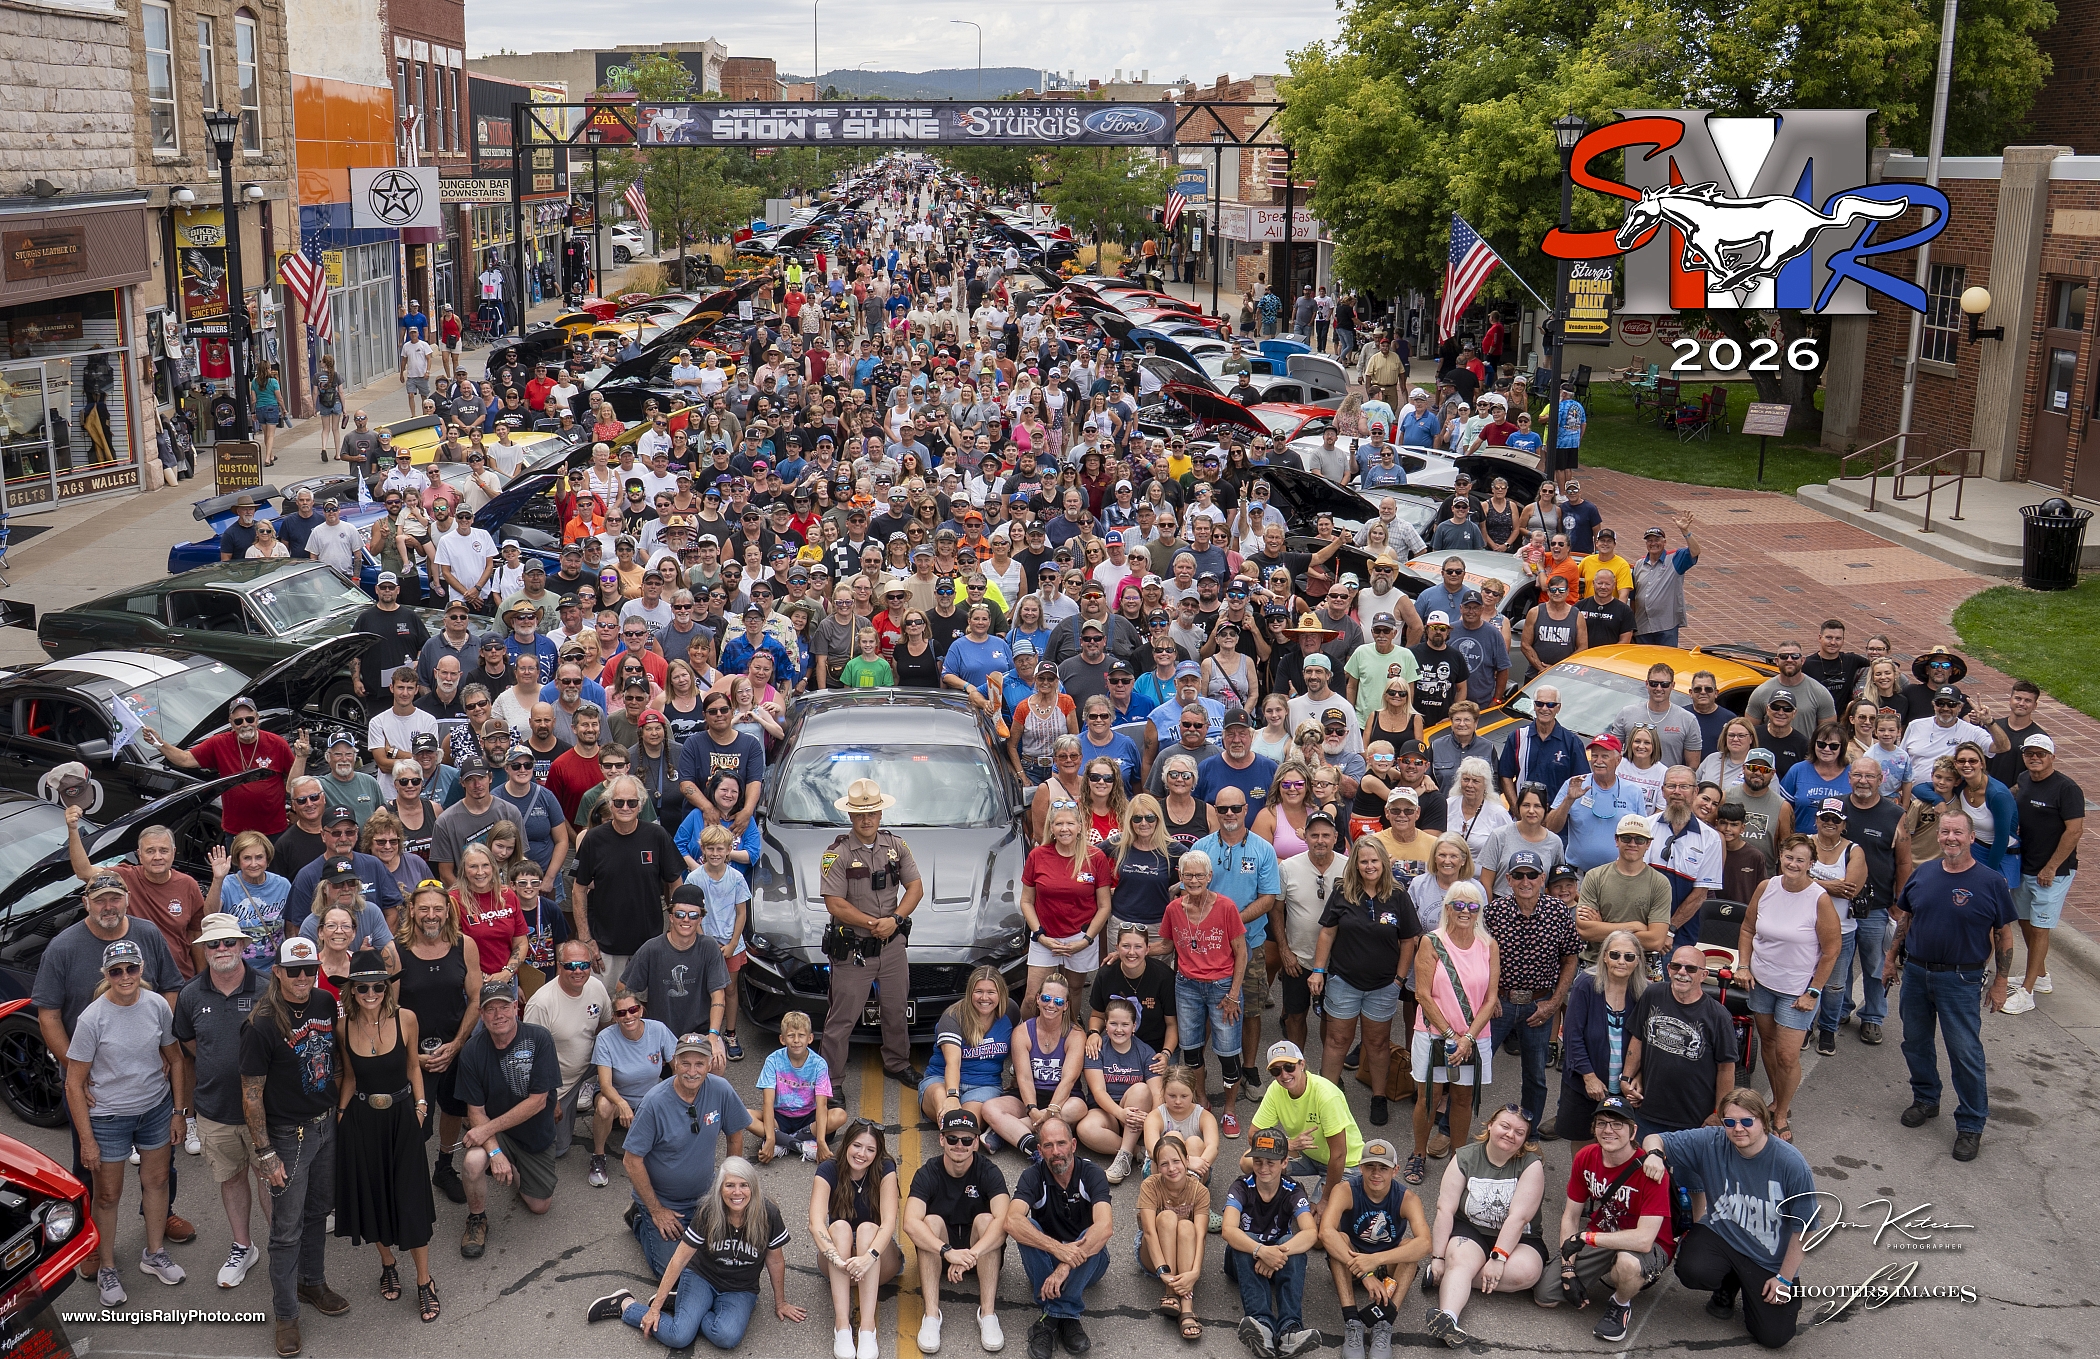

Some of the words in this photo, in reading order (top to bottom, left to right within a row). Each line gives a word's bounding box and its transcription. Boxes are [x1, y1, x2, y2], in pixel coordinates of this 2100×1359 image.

[719, 108, 838, 118] WELCOME
[845, 108, 878, 118] TO
[884, 108, 932, 118] THE
[991, 107, 1077, 117] WAREING
[593, 115, 637, 125] FARO
[965, 106, 1081, 137] STURGIS
[1100, 111, 1149, 133] Ford
[712, 119, 805, 140] SHOW
[815, 122, 833, 139] &
[842, 118, 940, 139] SHINE
[490, 179, 510, 188] BAR
[1175, 174, 1205, 184] TTOO
[441, 189, 506, 197] DOWNSTAIRS
[1258, 211, 1317, 224] Breafas
[190, 227, 217, 237] BIKER
[1264, 226, 1282, 238] All
[1291, 226, 1310, 238] Day
[194, 235, 214, 243] LIFE
[15, 249, 41, 260] STURGIS
[42, 246, 69, 257] LEATHER
[69, 244, 77, 253] CO
[322, 253, 341, 263] PPAREL
[1571, 262, 1613, 281] Sturgis
[1569, 279, 1613, 295] OFFICIAL
[1575, 294, 1606, 309] RALLY
[191, 309, 210, 319] SINCE
[210, 308, 223, 316] 1975
[1570, 308, 1609, 319] HEADQUARTERS
[958, 456, 979, 465] HELBY
[218, 463, 258, 474] CUSTOM
[57, 481, 84, 497] BAGS
[91, 471, 137, 490] WALLETS
[217, 476, 260, 486] LEATHER
[9, 488, 46, 505] BELTS
[1538, 625, 1570, 643] SLALOM
[539, 653, 550, 685] 1776
[710, 755, 740, 768] RODEO
[1740, 832, 1766, 840] RIAT
[480, 908, 513, 920] ROUSH
[962, 1042, 1008, 1059] MUSTANG
[710, 1240, 759, 1258] MUSTANG
